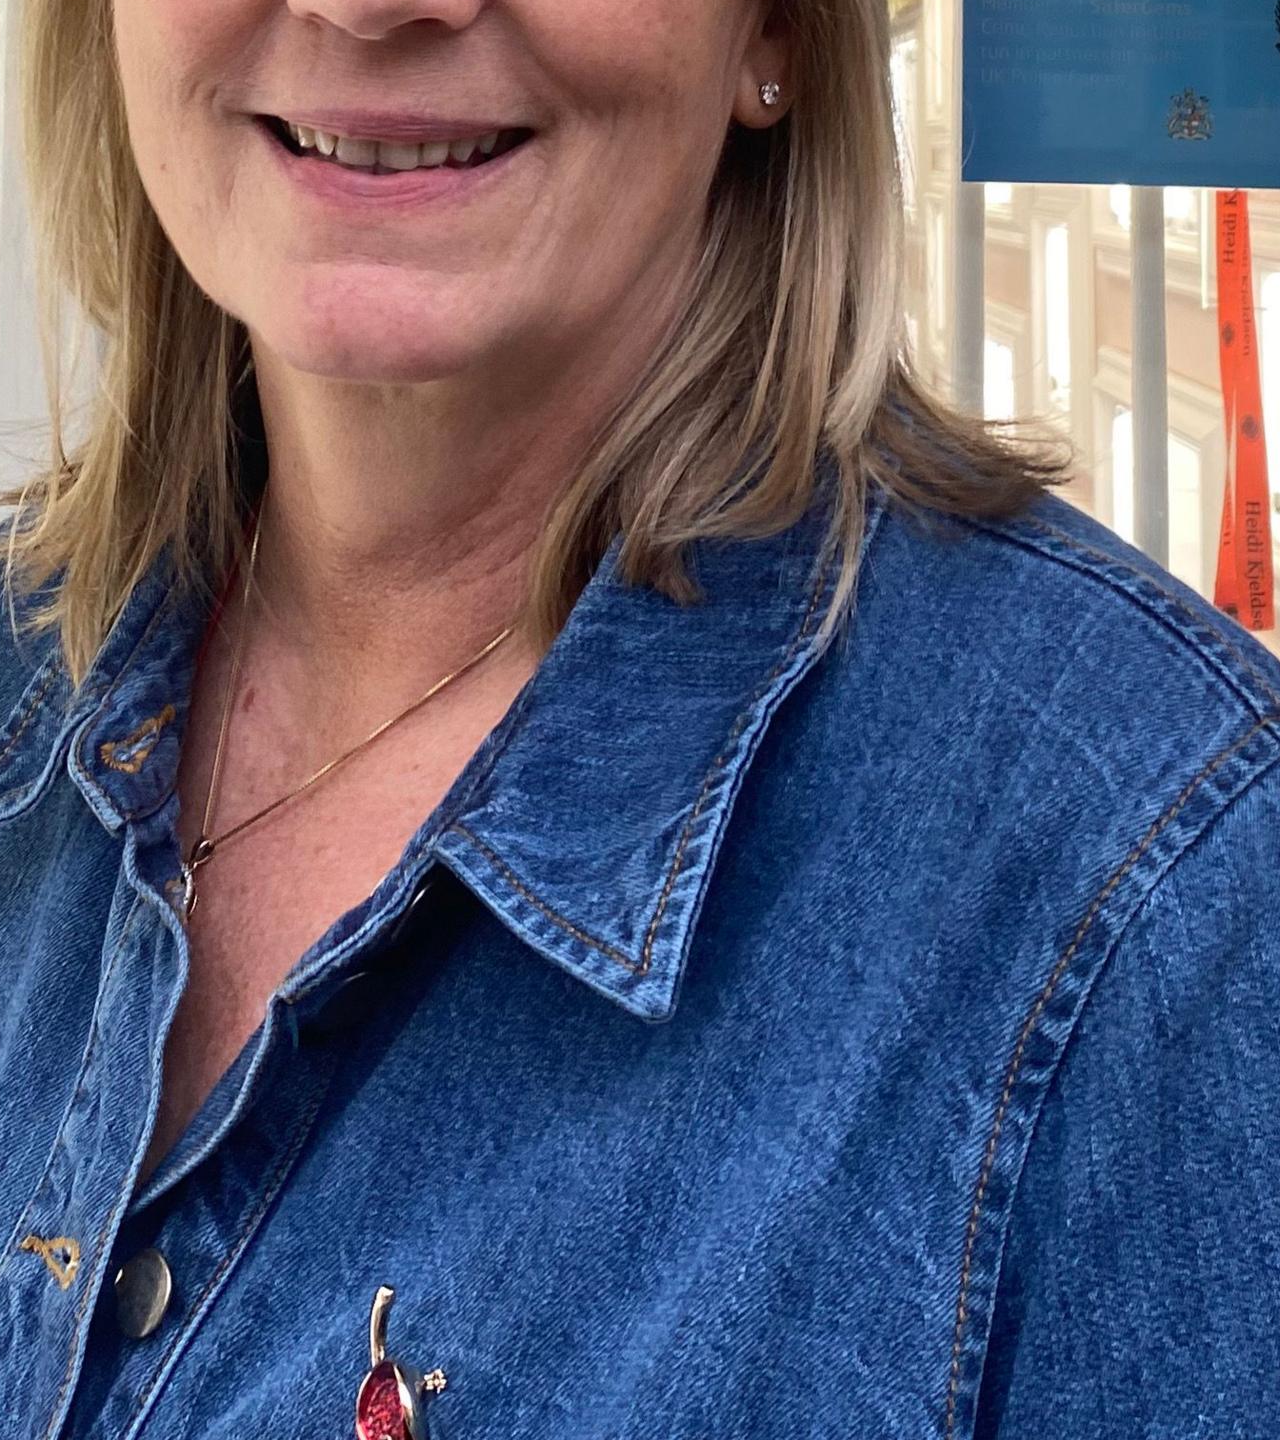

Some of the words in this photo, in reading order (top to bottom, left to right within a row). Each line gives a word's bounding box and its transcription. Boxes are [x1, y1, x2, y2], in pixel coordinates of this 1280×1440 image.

[1222, 213, 1238, 264] Heidi
[1245, 501, 1264, 553] Heidi
[1245, 560, 1267, 631] Kjeldse
